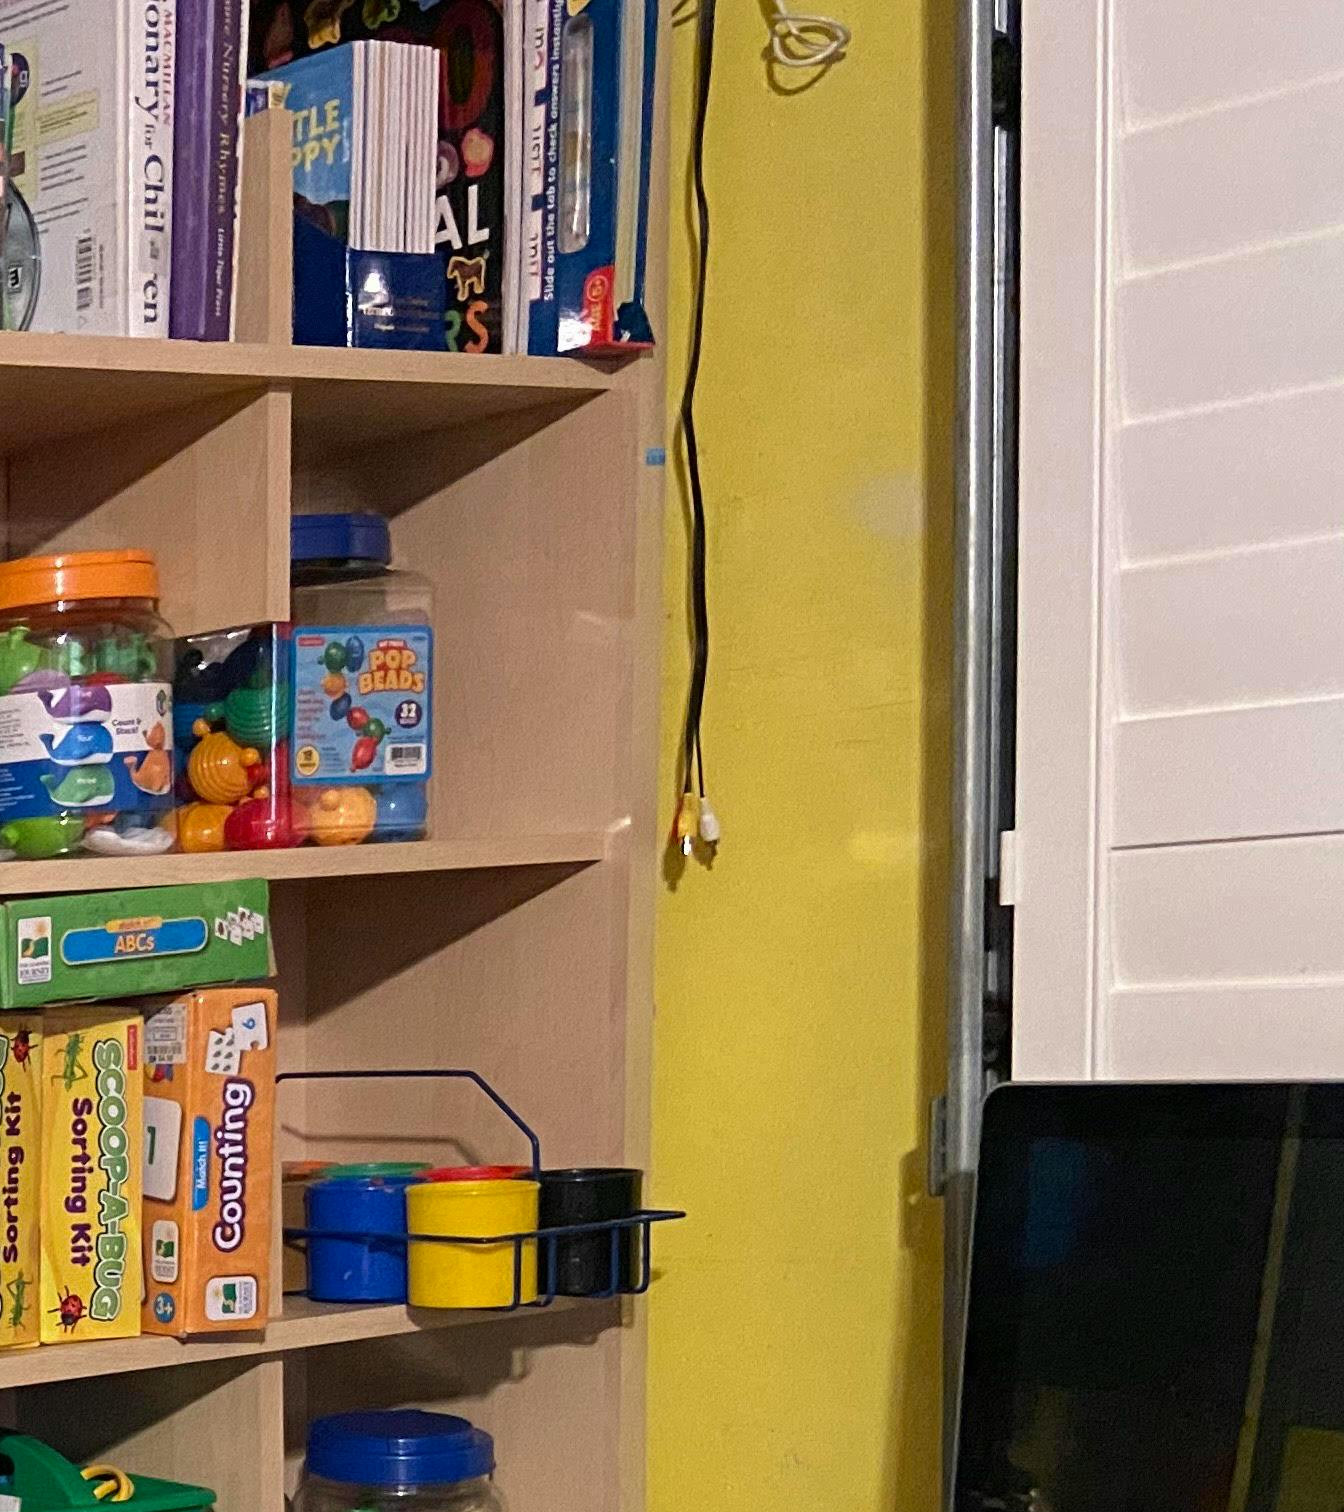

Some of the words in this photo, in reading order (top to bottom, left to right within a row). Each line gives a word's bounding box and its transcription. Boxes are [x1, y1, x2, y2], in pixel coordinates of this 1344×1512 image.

[135, 0, 160, 121] onary
[218, 42, 233, 123] Nursery
[550, 63, 560, 119] answers
[145, 124, 155, 149] for
[292, 98, 340, 141] TLE
[548, 123, 557, 162] check
[548, 167, 556, 183] to
[434, 184, 489, 250] AL
[547, 186, 555, 209] tab
[143, 154, 165, 323] Chilen
[547, 213, 555, 237] the
[547, 240, 555, 264] out
[544, 267, 554, 301] Slide
[369, 649, 416, 671] POP
[359, 671, 425, 695] BEADS
[114, 934, 155, 953] ABCs
[242, 1017, 256, 1030] 6
[5, 1091, 22, 1137] Kit
[63, 1097, 94, 1213] Sorting
[147, 1126, 156, 1165] 1
[213, 1077, 254, 1252] Counting
[90, 1038, 129, 1322] SCOOP-A-BUG
[196, 1154, 207, 1189] Match
[3, 1145, 25, 1264] Sorting
[68, 1222, 93, 1267] Kit
[156, 1296, 173, 1315] 3+
